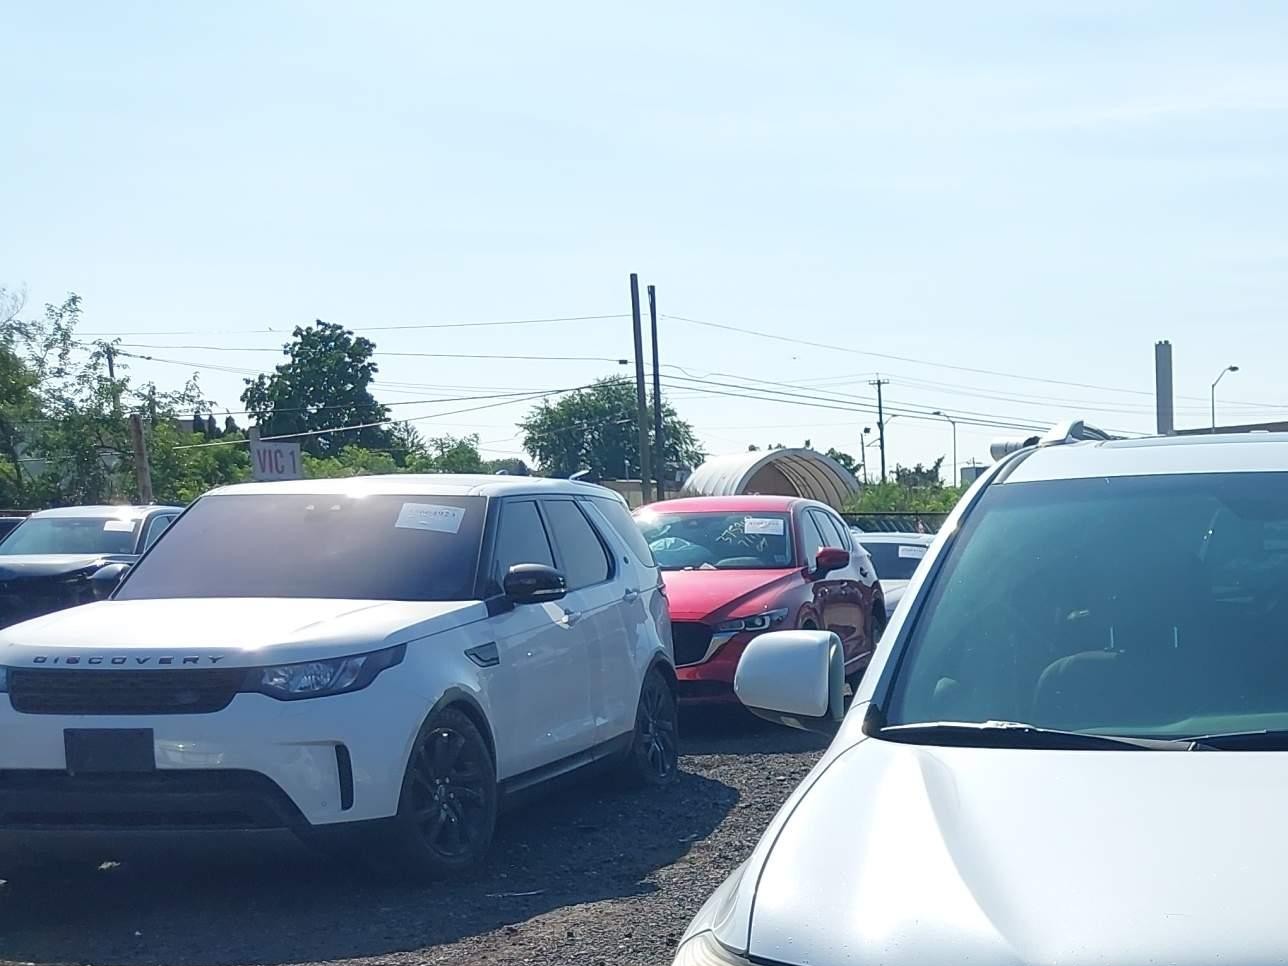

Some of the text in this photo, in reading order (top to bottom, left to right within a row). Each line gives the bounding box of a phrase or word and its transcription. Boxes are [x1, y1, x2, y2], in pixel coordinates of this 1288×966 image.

[256, 448, 297, 474] VIC 1
[32, 655, 225, 665] DISCOVERY
